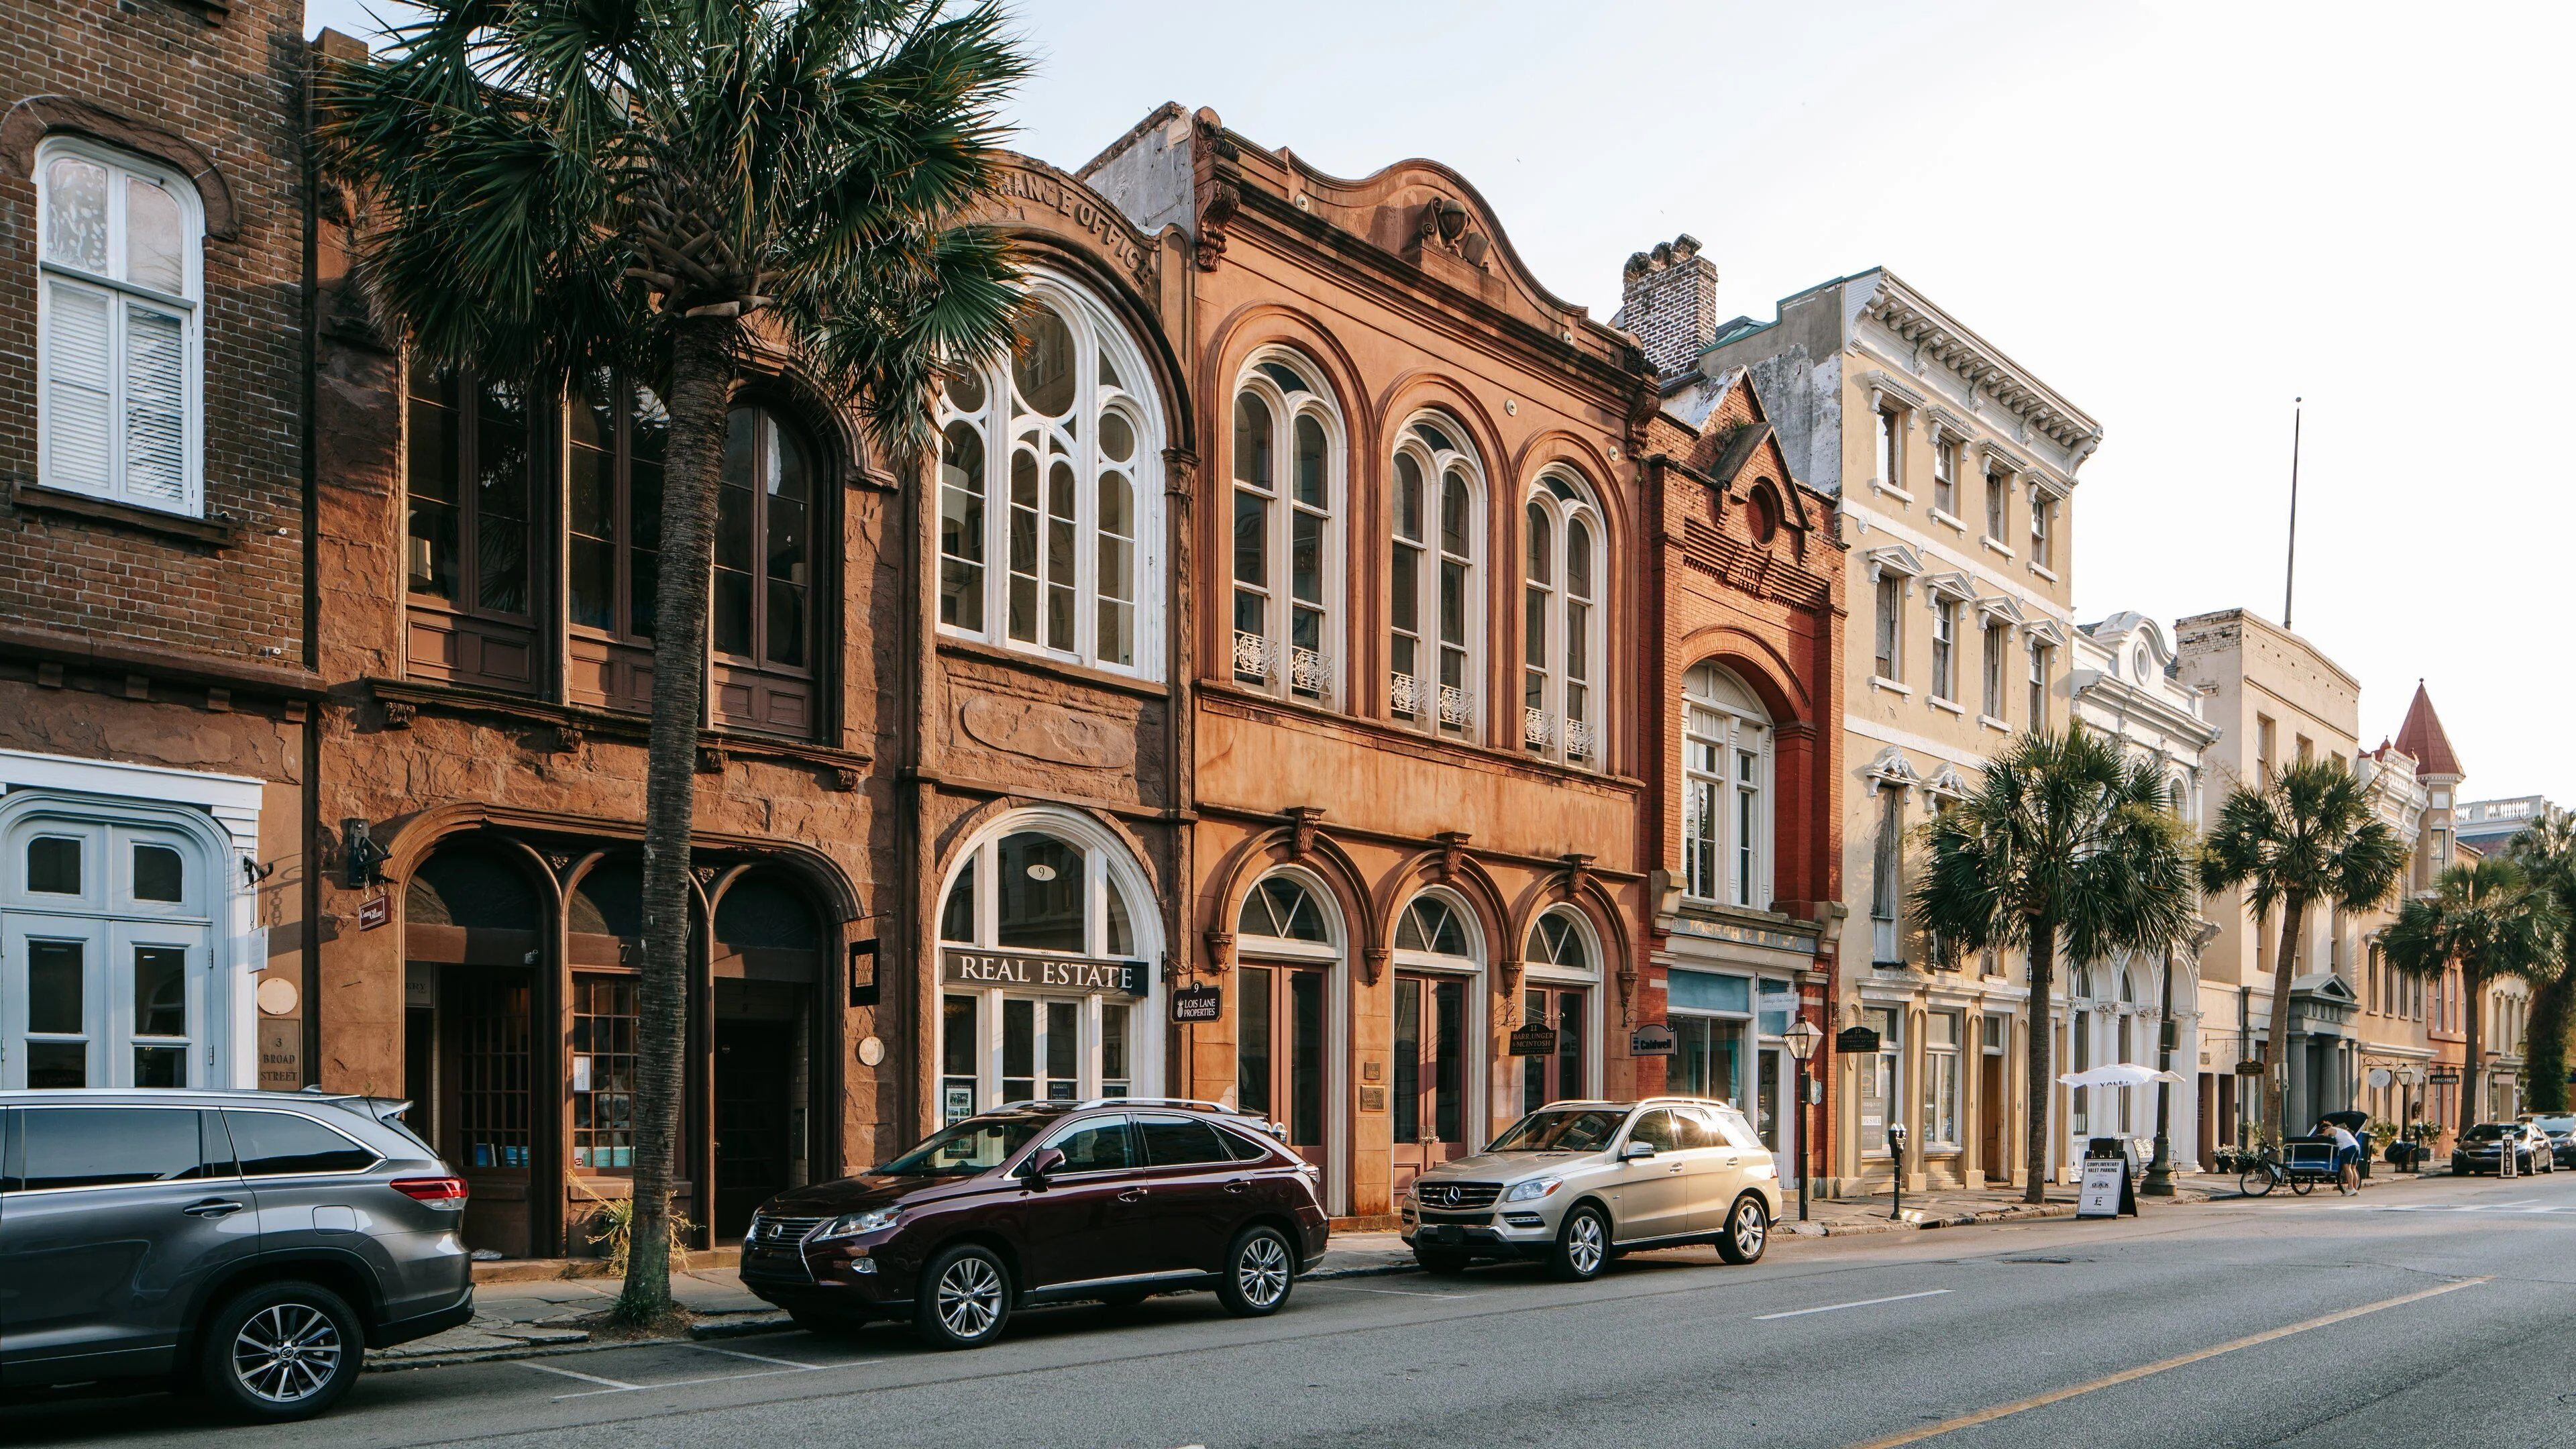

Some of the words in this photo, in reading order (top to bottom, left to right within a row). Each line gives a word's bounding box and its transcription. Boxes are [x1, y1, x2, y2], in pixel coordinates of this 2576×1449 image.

[1074, 203, 1154, 285] OFFICE
[1038, 867, 1045, 878] 9
[1684, 920, 1741, 940] JOSEPH
[1757, 930, 1799, 949] RILEY
[620, 943, 633, 963] 7
[959, 956, 1031, 983] REAL
[1041, 961, 1132, 989] ESTATE
[1194, 983, 1199, 993] 9
[1185, 999, 1198, 1008] LOIS
[1199, 998, 1216, 1008] LANE
[1183, 1008, 1215, 1017] PROPERTIES
[275, 1038, 282, 1047] 3
[1640, 1039, 1672, 1050] Caldwell
[263, 1054, 295, 1064] BROAD
[260, 1071, 298, 1081] STREET
